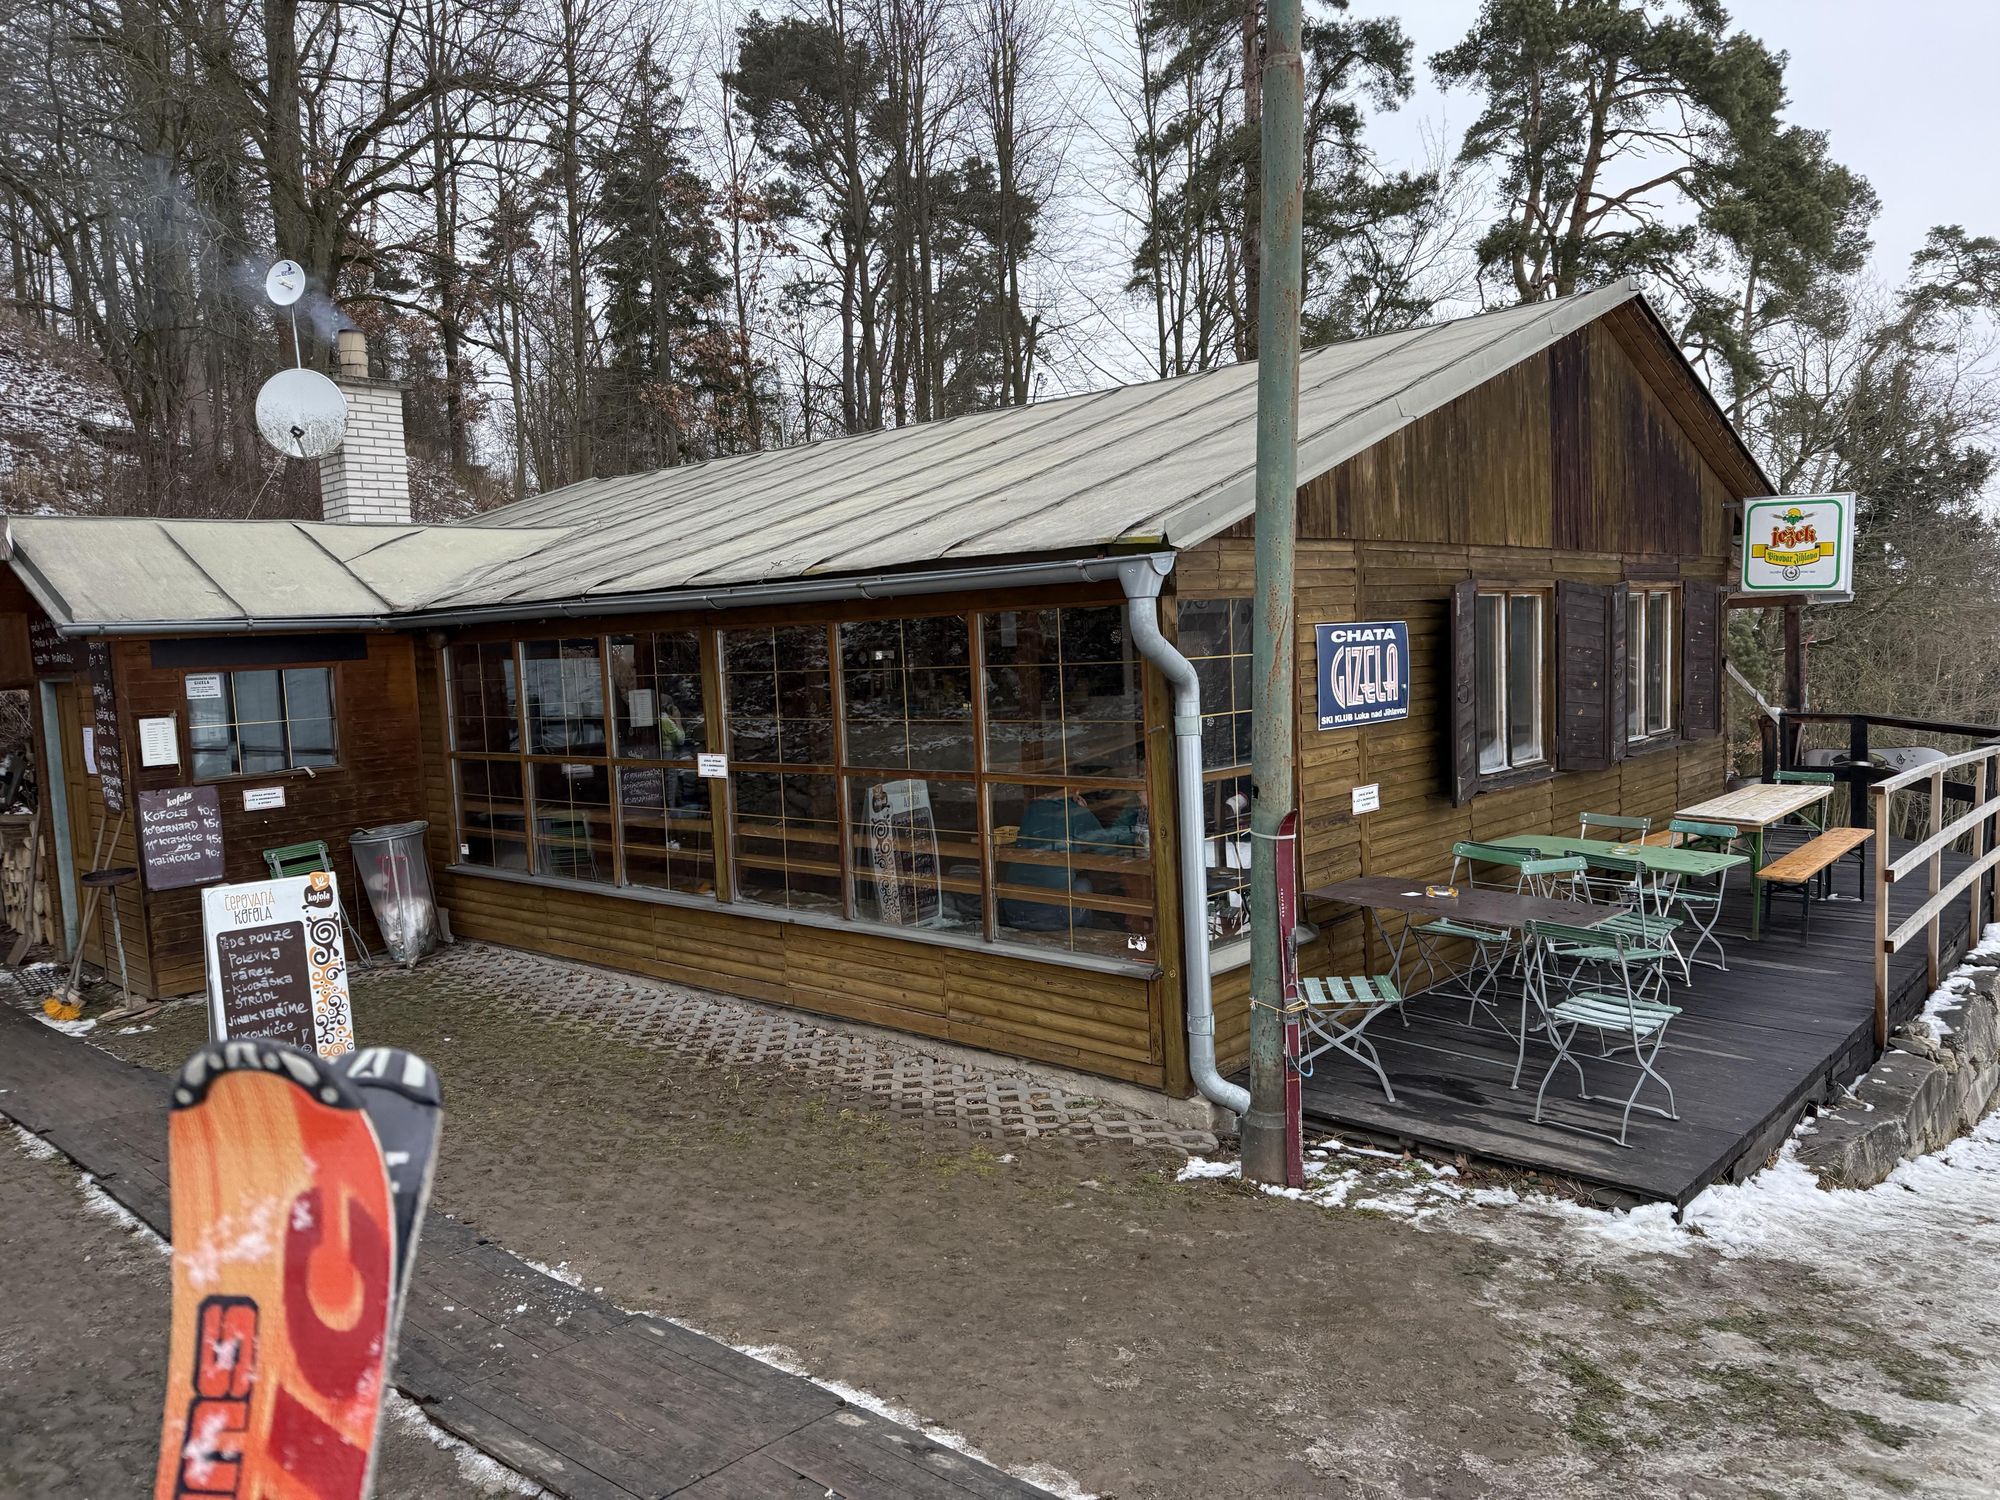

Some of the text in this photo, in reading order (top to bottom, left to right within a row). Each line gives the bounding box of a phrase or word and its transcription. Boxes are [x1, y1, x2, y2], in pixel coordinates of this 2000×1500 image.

[1331, 628, 1396, 643] CHATA
[1331, 643, 1398, 709] GIZELA
[1321, 707, 1407, 725] SKI KLUB Luka nad Jihlavou
[166, 791, 193, 808] kofola
[307, 890, 330, 904] kofola
[234, 906, 273, 925] KOFOLA
